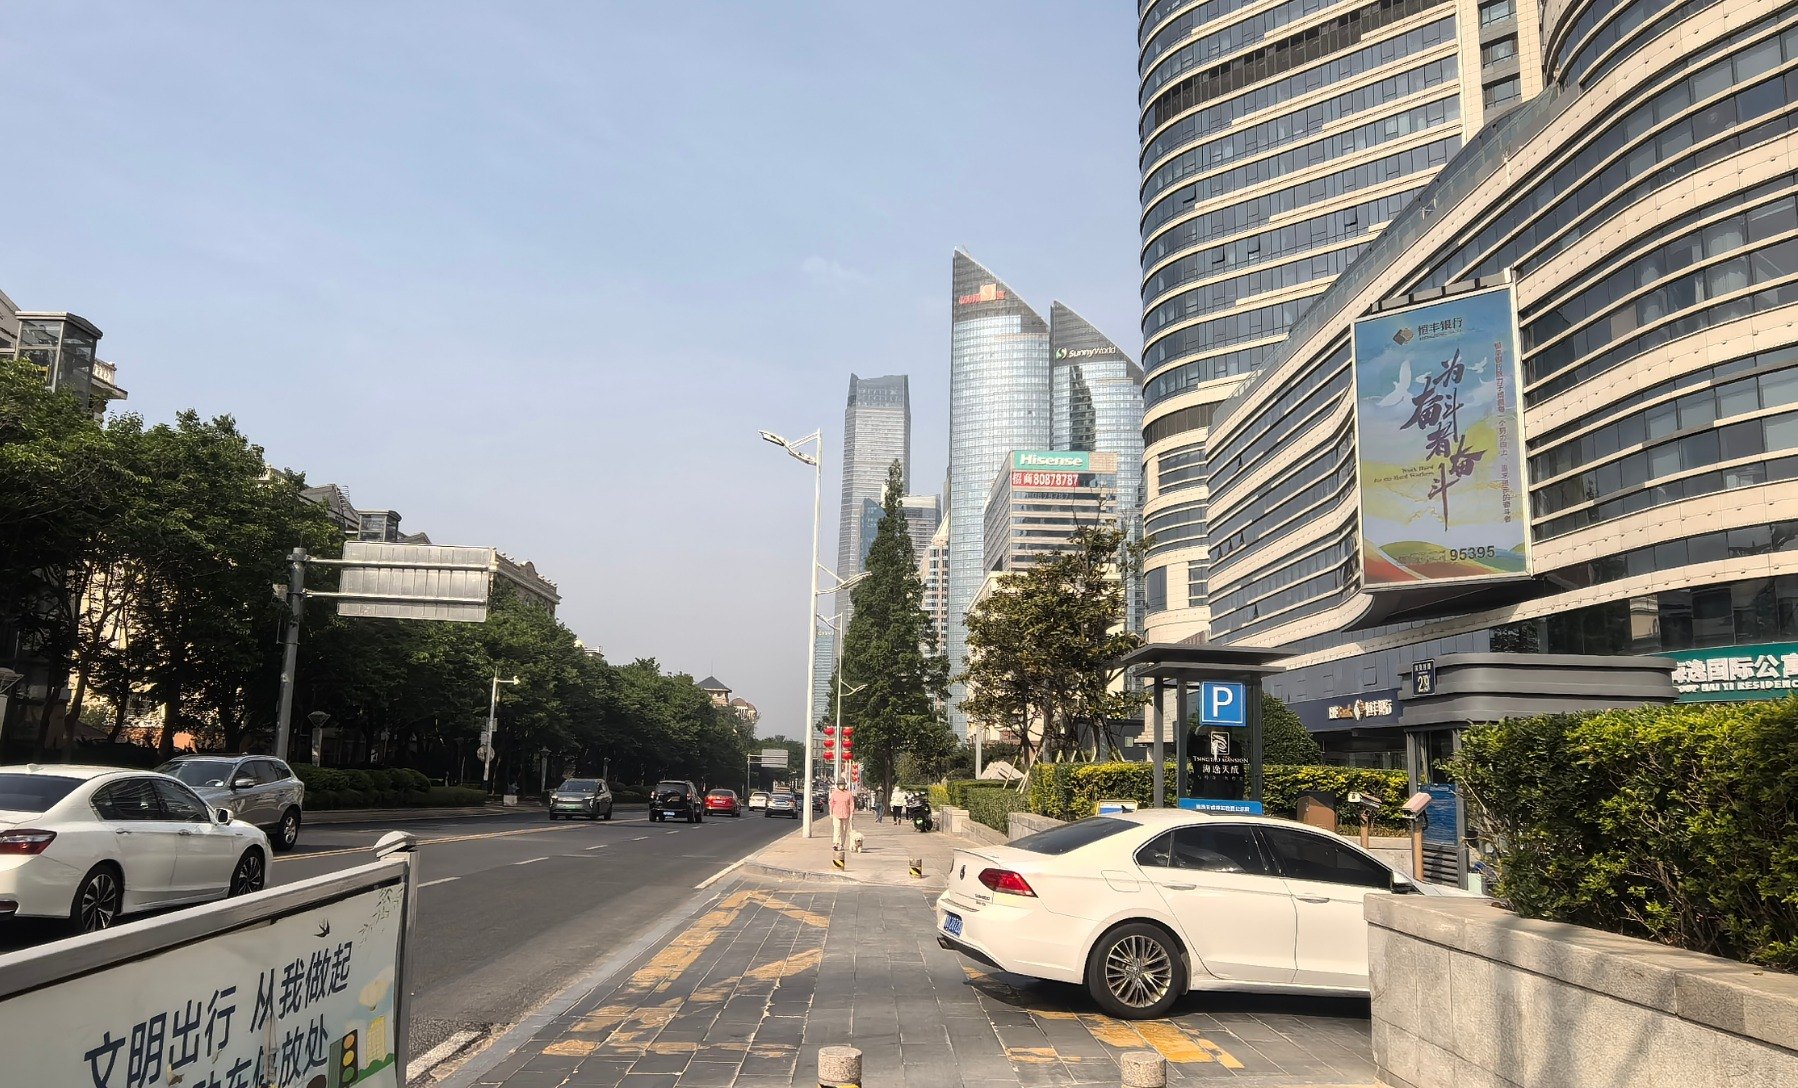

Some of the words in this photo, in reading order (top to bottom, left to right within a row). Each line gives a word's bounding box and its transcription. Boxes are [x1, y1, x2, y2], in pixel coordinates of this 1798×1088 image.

[1418, 317, 1463, 336] 恒丰银行
[1020, 453, 1083, 466] Hisense
[1450, 545, 1495, 562] 95395
[1212, 686, 1233, 717] P
[84, 985, 237, 1088] 文明出行
[250, 941, 353, 1033] 从我做起
